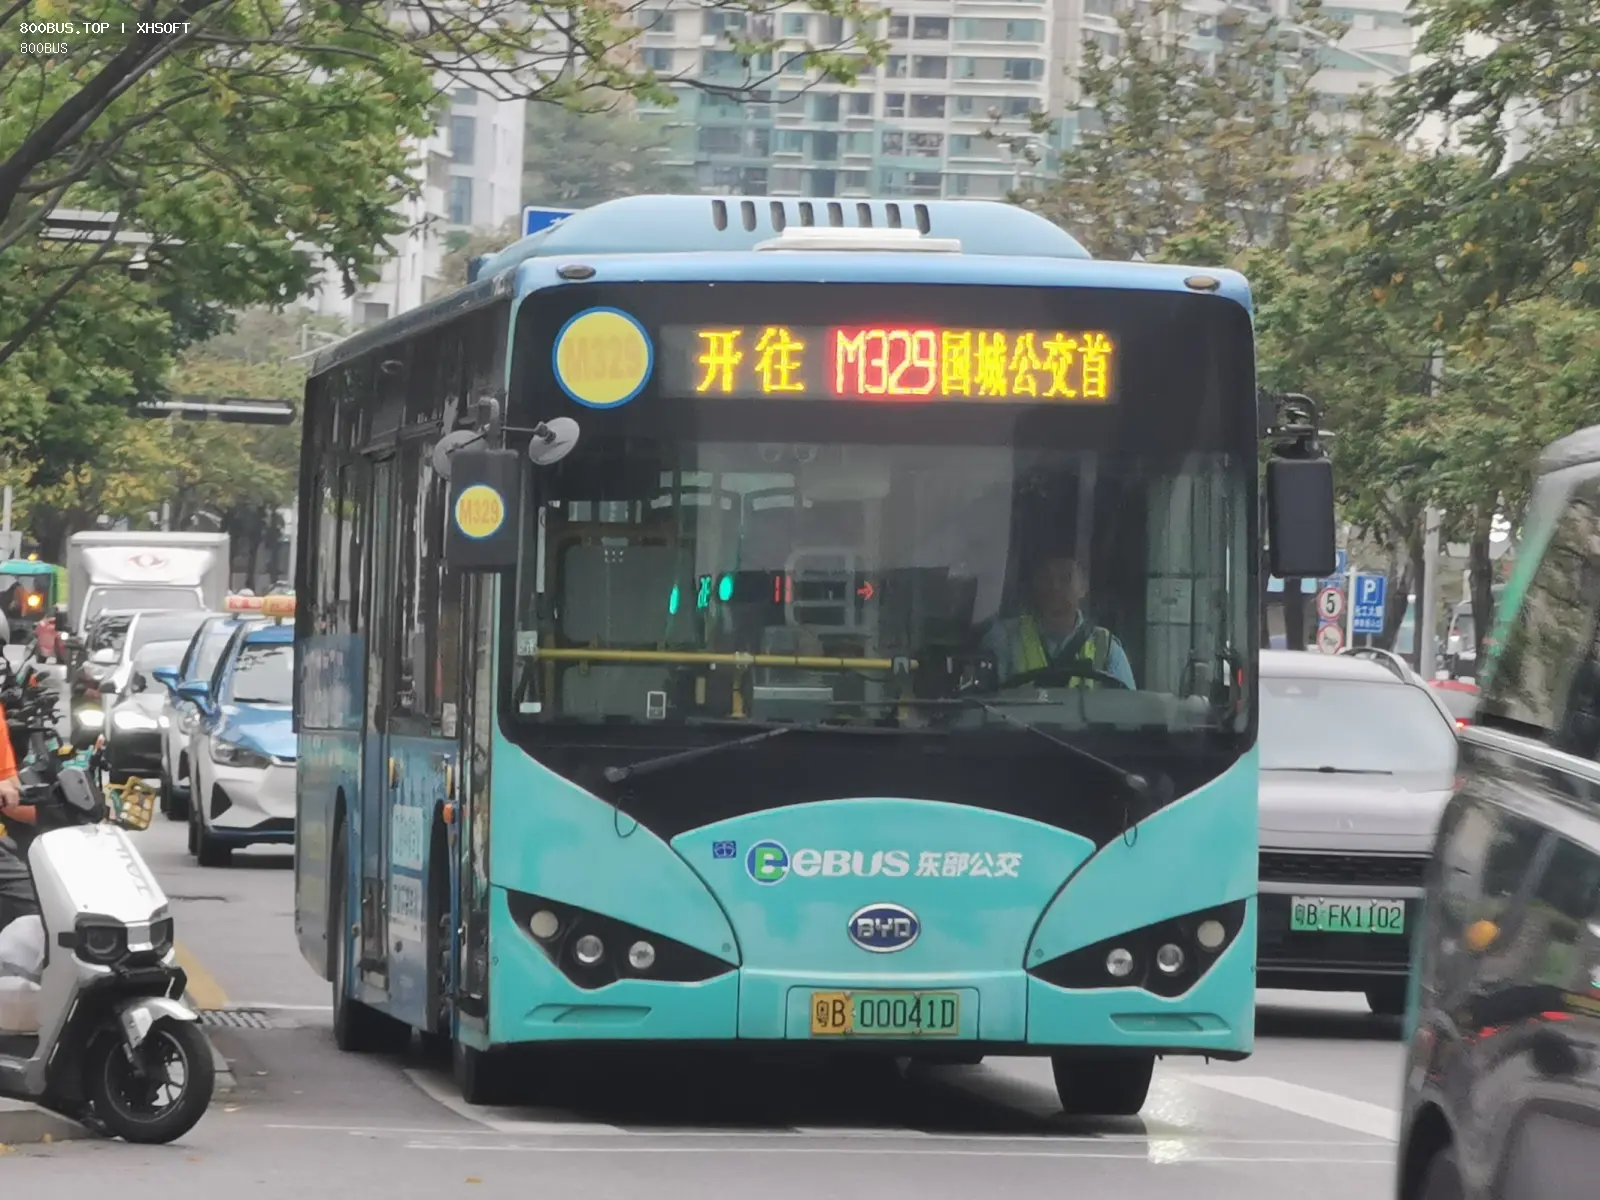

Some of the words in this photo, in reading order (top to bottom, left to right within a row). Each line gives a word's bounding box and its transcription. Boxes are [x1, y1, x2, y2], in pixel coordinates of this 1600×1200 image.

[697, 327, 805, 393] 开往
[836, 330, 938, 395] M329
[460, 499, 500, 525] M329
[1326, 592, 1335, 613] 5
[1363, 579, 1377, 604] P
[792, 848, 910, 878] eBUS
[914, 851, 1023, 878] 东部公交
[857, 917, 911, 938] BYD
[1328, 904, 1402, 929] FK1102
[860, 999, 956, 1029] 00041D
